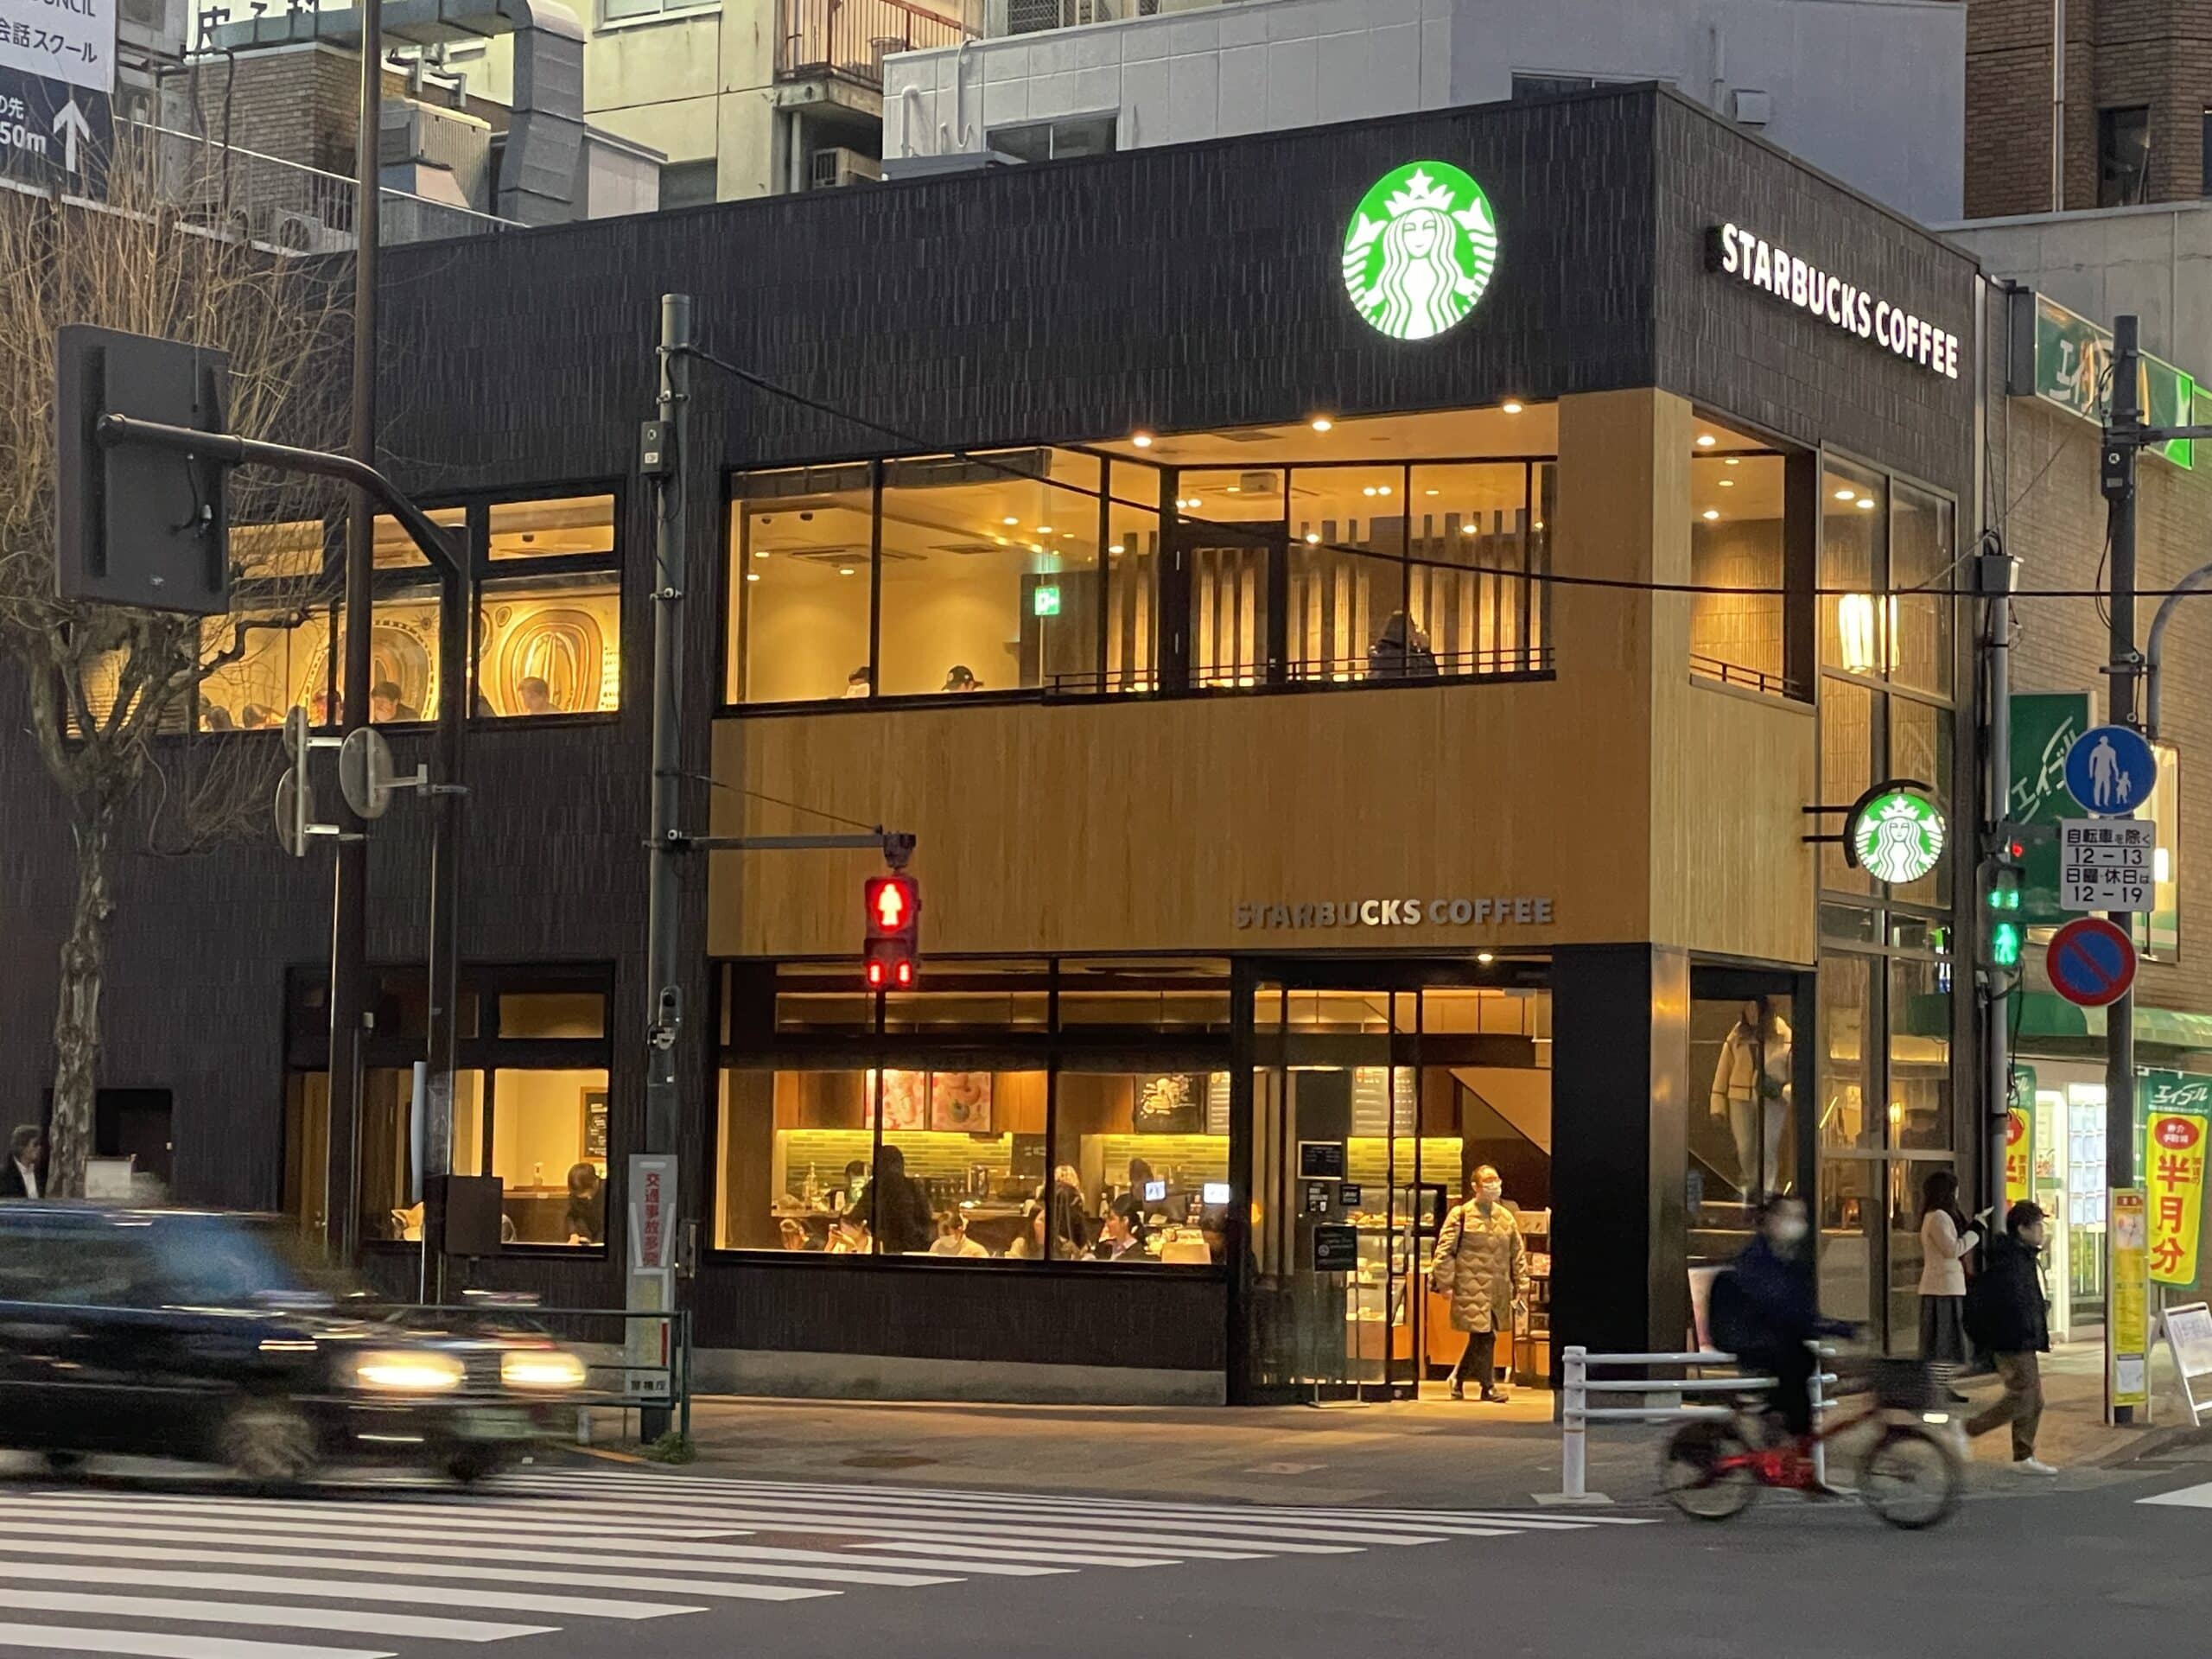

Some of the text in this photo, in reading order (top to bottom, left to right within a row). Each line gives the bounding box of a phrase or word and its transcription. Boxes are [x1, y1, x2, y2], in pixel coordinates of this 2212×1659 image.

[0, 121, 47, 154] 50m
[1722, 222, 1958, 379] STARBUCKS COFFEE
[2067, 829, 2151, 845] 自転車を除く
[1236, 898, 1554, 929] STARBUCKS COFFEE
[2150, 1154, 2190, 1274] 半月分
